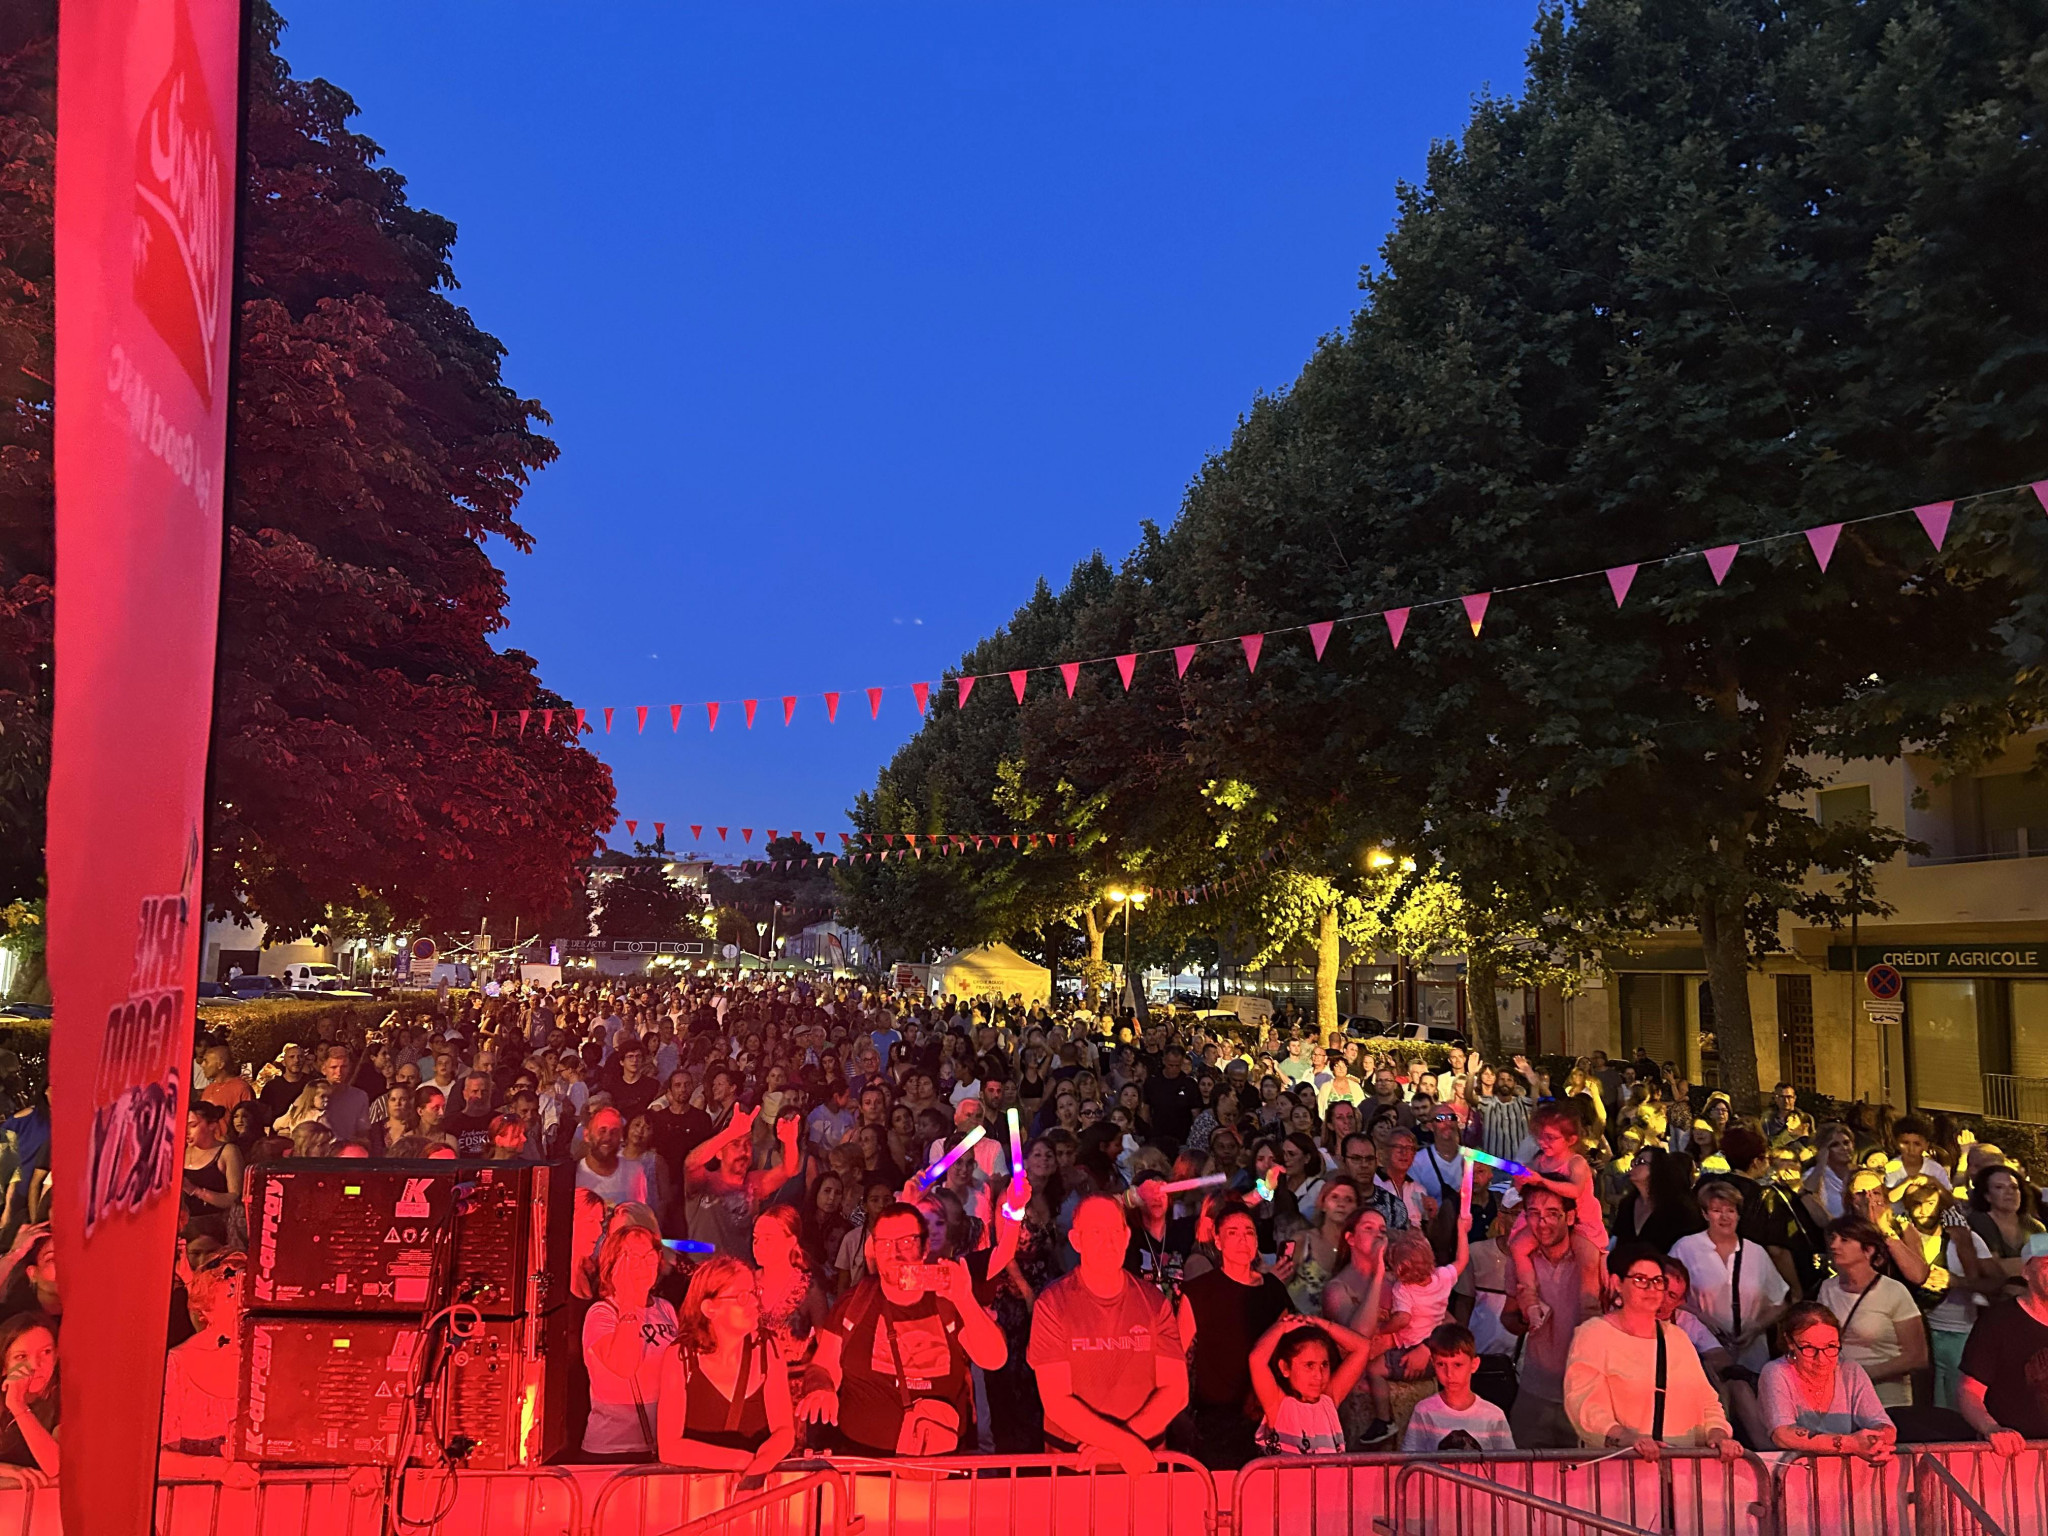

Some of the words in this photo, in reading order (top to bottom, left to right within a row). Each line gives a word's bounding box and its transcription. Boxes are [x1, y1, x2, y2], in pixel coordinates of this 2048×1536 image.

[1882, 951, 1940, 965] CRÉDIT
[1947, 951, 2039, 966] AGRICOLE
[254, 1179, 284, 1302] K-array
[245, 1325, 272, 1456] K-array
